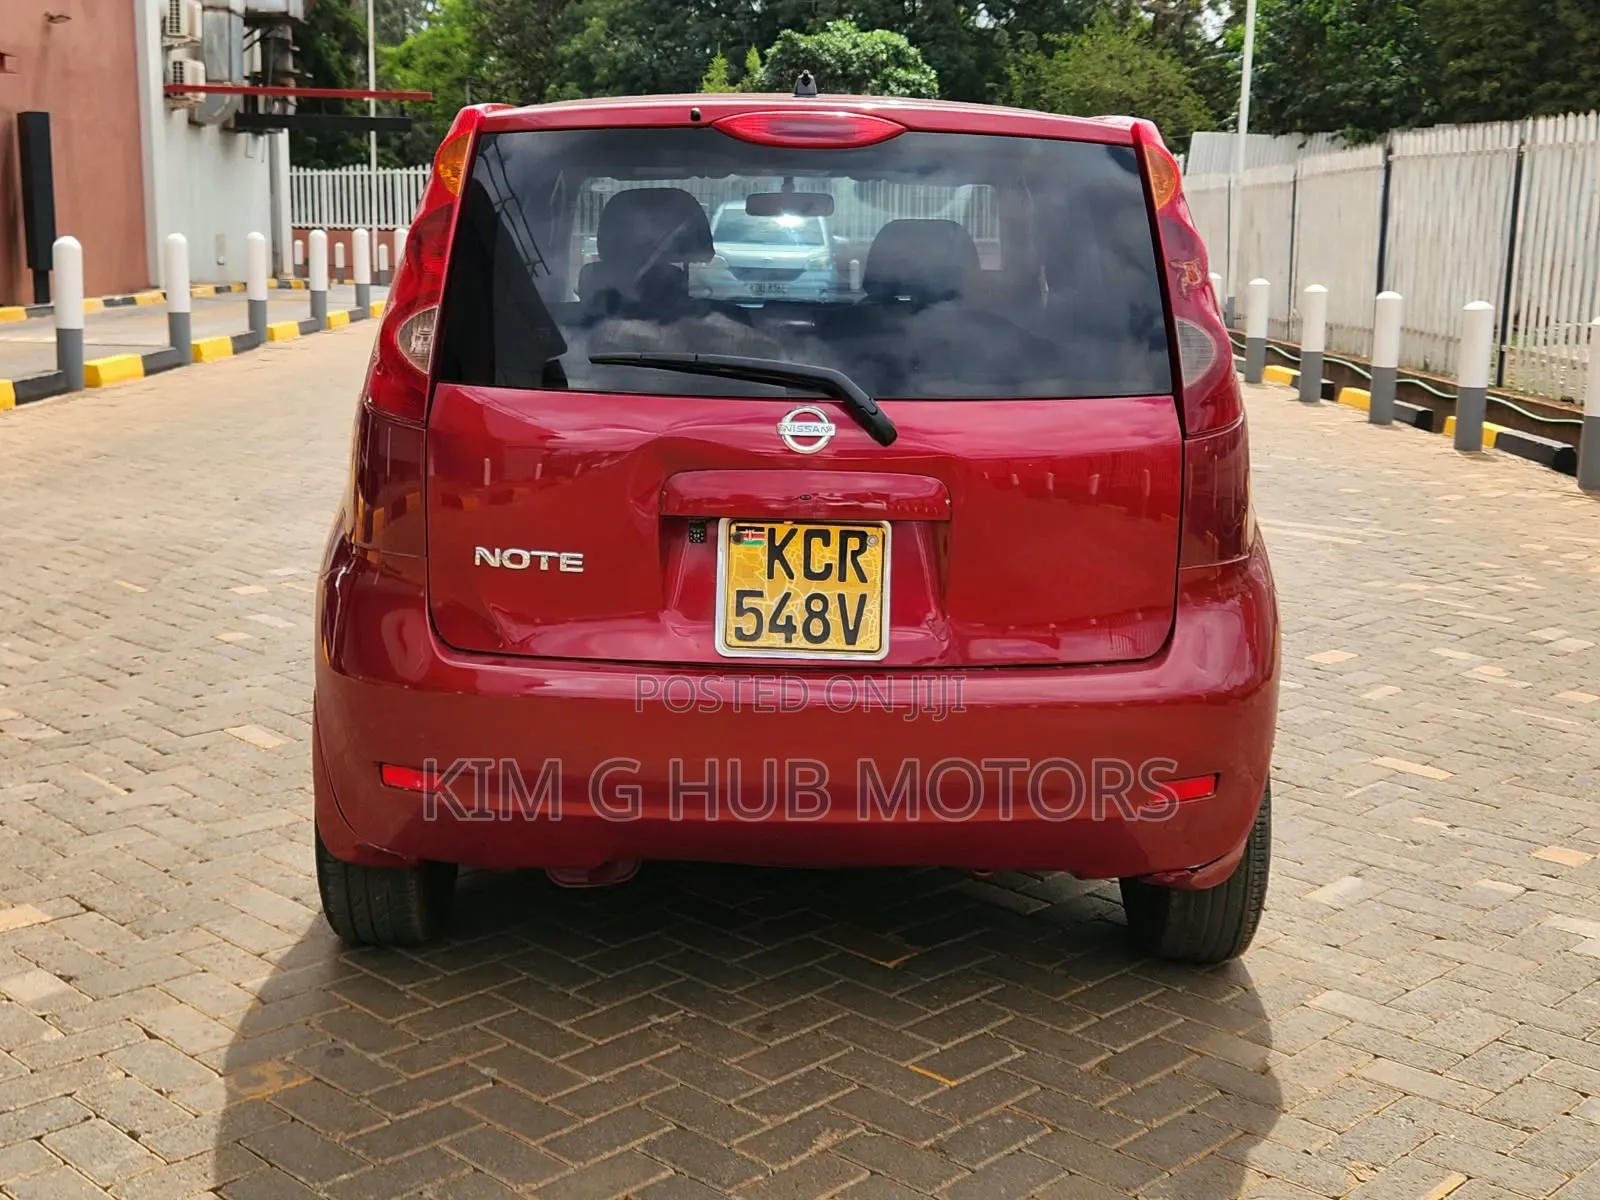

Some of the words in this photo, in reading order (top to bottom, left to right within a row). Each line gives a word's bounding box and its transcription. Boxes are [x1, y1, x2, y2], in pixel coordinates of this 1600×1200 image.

[780, 424, 831, 433] NISSAN
[474, 546, 584, 573] NOTE
[766, 527, 868, 584] KCR
[734, 589, 868, 646] 548V
